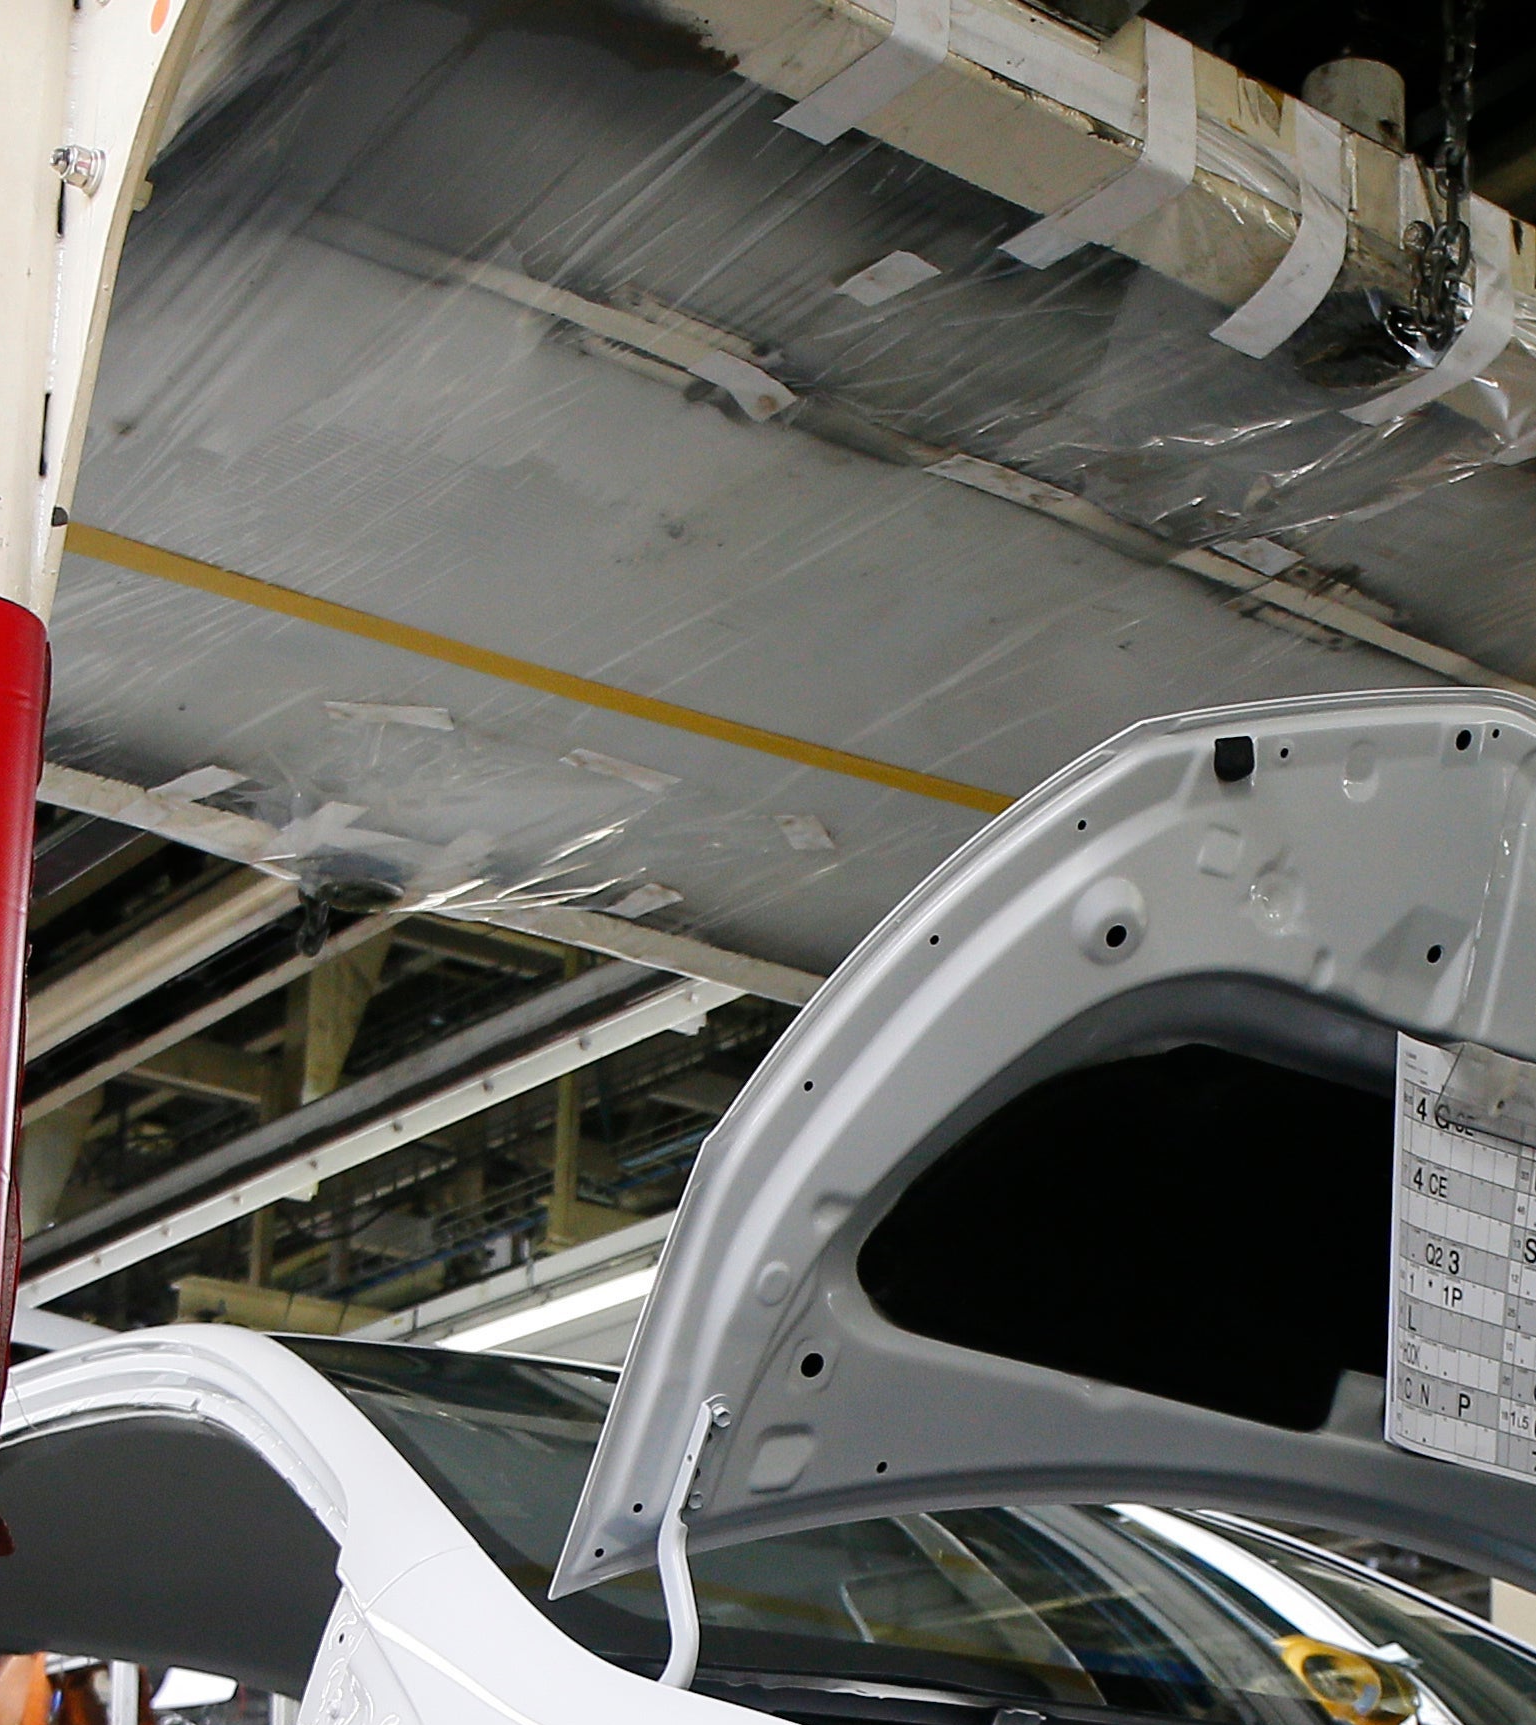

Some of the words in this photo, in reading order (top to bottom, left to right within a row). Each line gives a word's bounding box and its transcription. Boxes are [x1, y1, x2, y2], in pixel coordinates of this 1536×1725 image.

[1416, 1097, 1427, 1121] 4
[1413, 1166, 1424, 1192] 4
[1429, 1172, 1449, 1199] CE
[1425, 1243, 1444, 1268] Q2
[1448, 1250, 1461, 1276] 3
[1443, 1285, 1464, 1309] 1P
[1407, 1304, 1418, 1332] L
[1404, 1376, 1413, 1401] C
[1420, 1383, 1431, 1407] N
[1458, 1392, 1472, 1418] P
